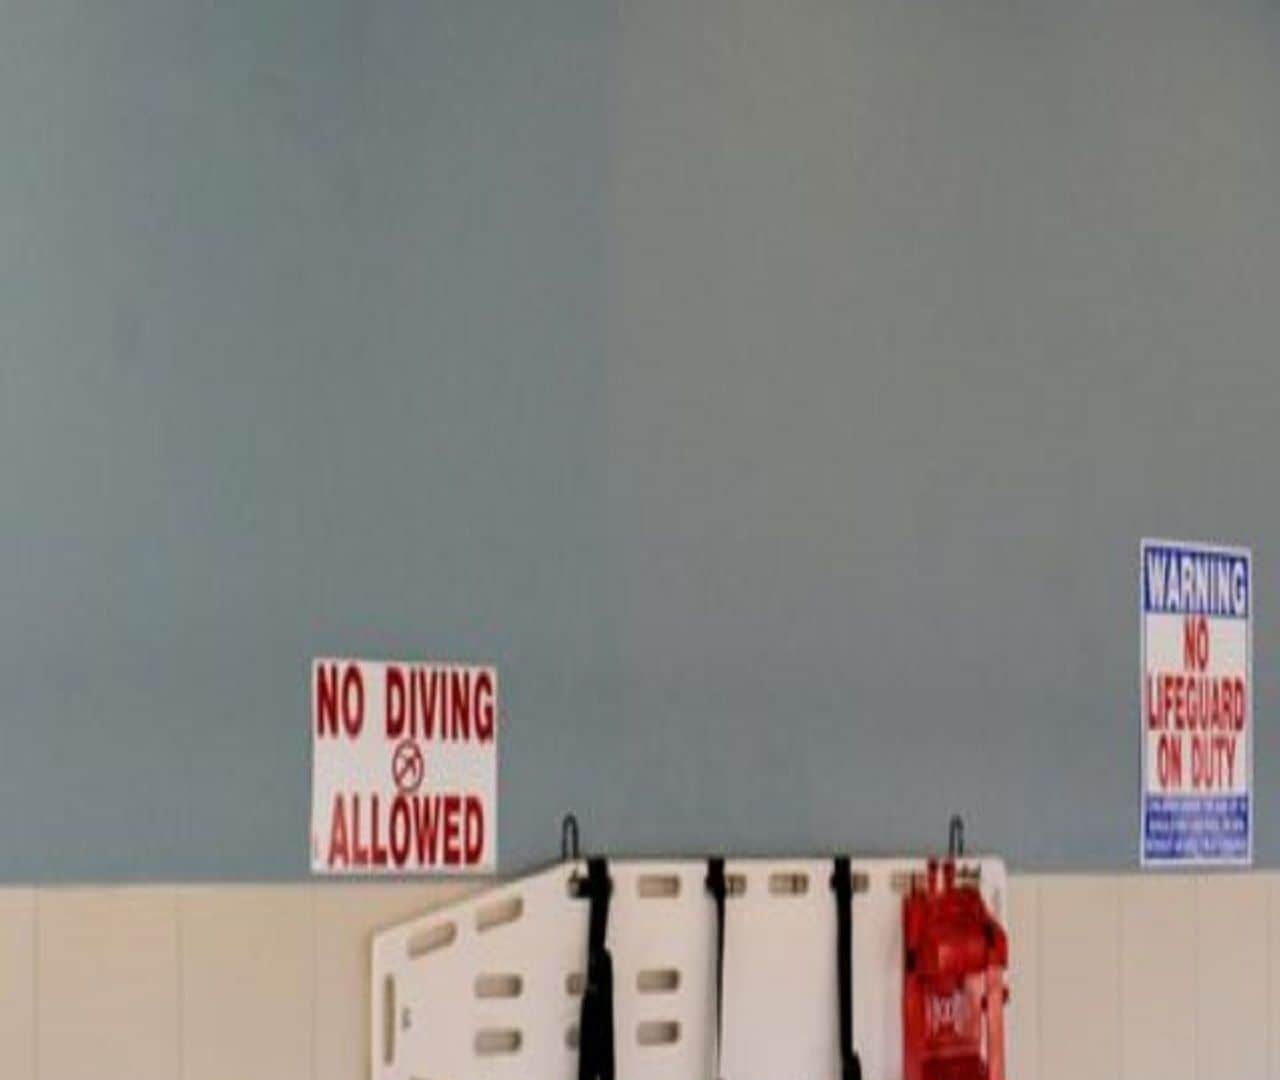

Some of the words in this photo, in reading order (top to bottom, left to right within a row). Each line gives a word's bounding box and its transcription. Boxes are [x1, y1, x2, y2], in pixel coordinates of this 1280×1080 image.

[1148, 550, 1246, 613] WARNING
[1184, 615, 1209, 672] NO
[317, 662, 364, 740] NO
[386, 665, 493, 743] DIVING
[1148, 674, 1245, 732] LIFEGUARD
[1157, 734, 1182, 789] ON
[1191, 734, 1237, 789] DUTY
[328, 791, 484, 869] ALLOWED
